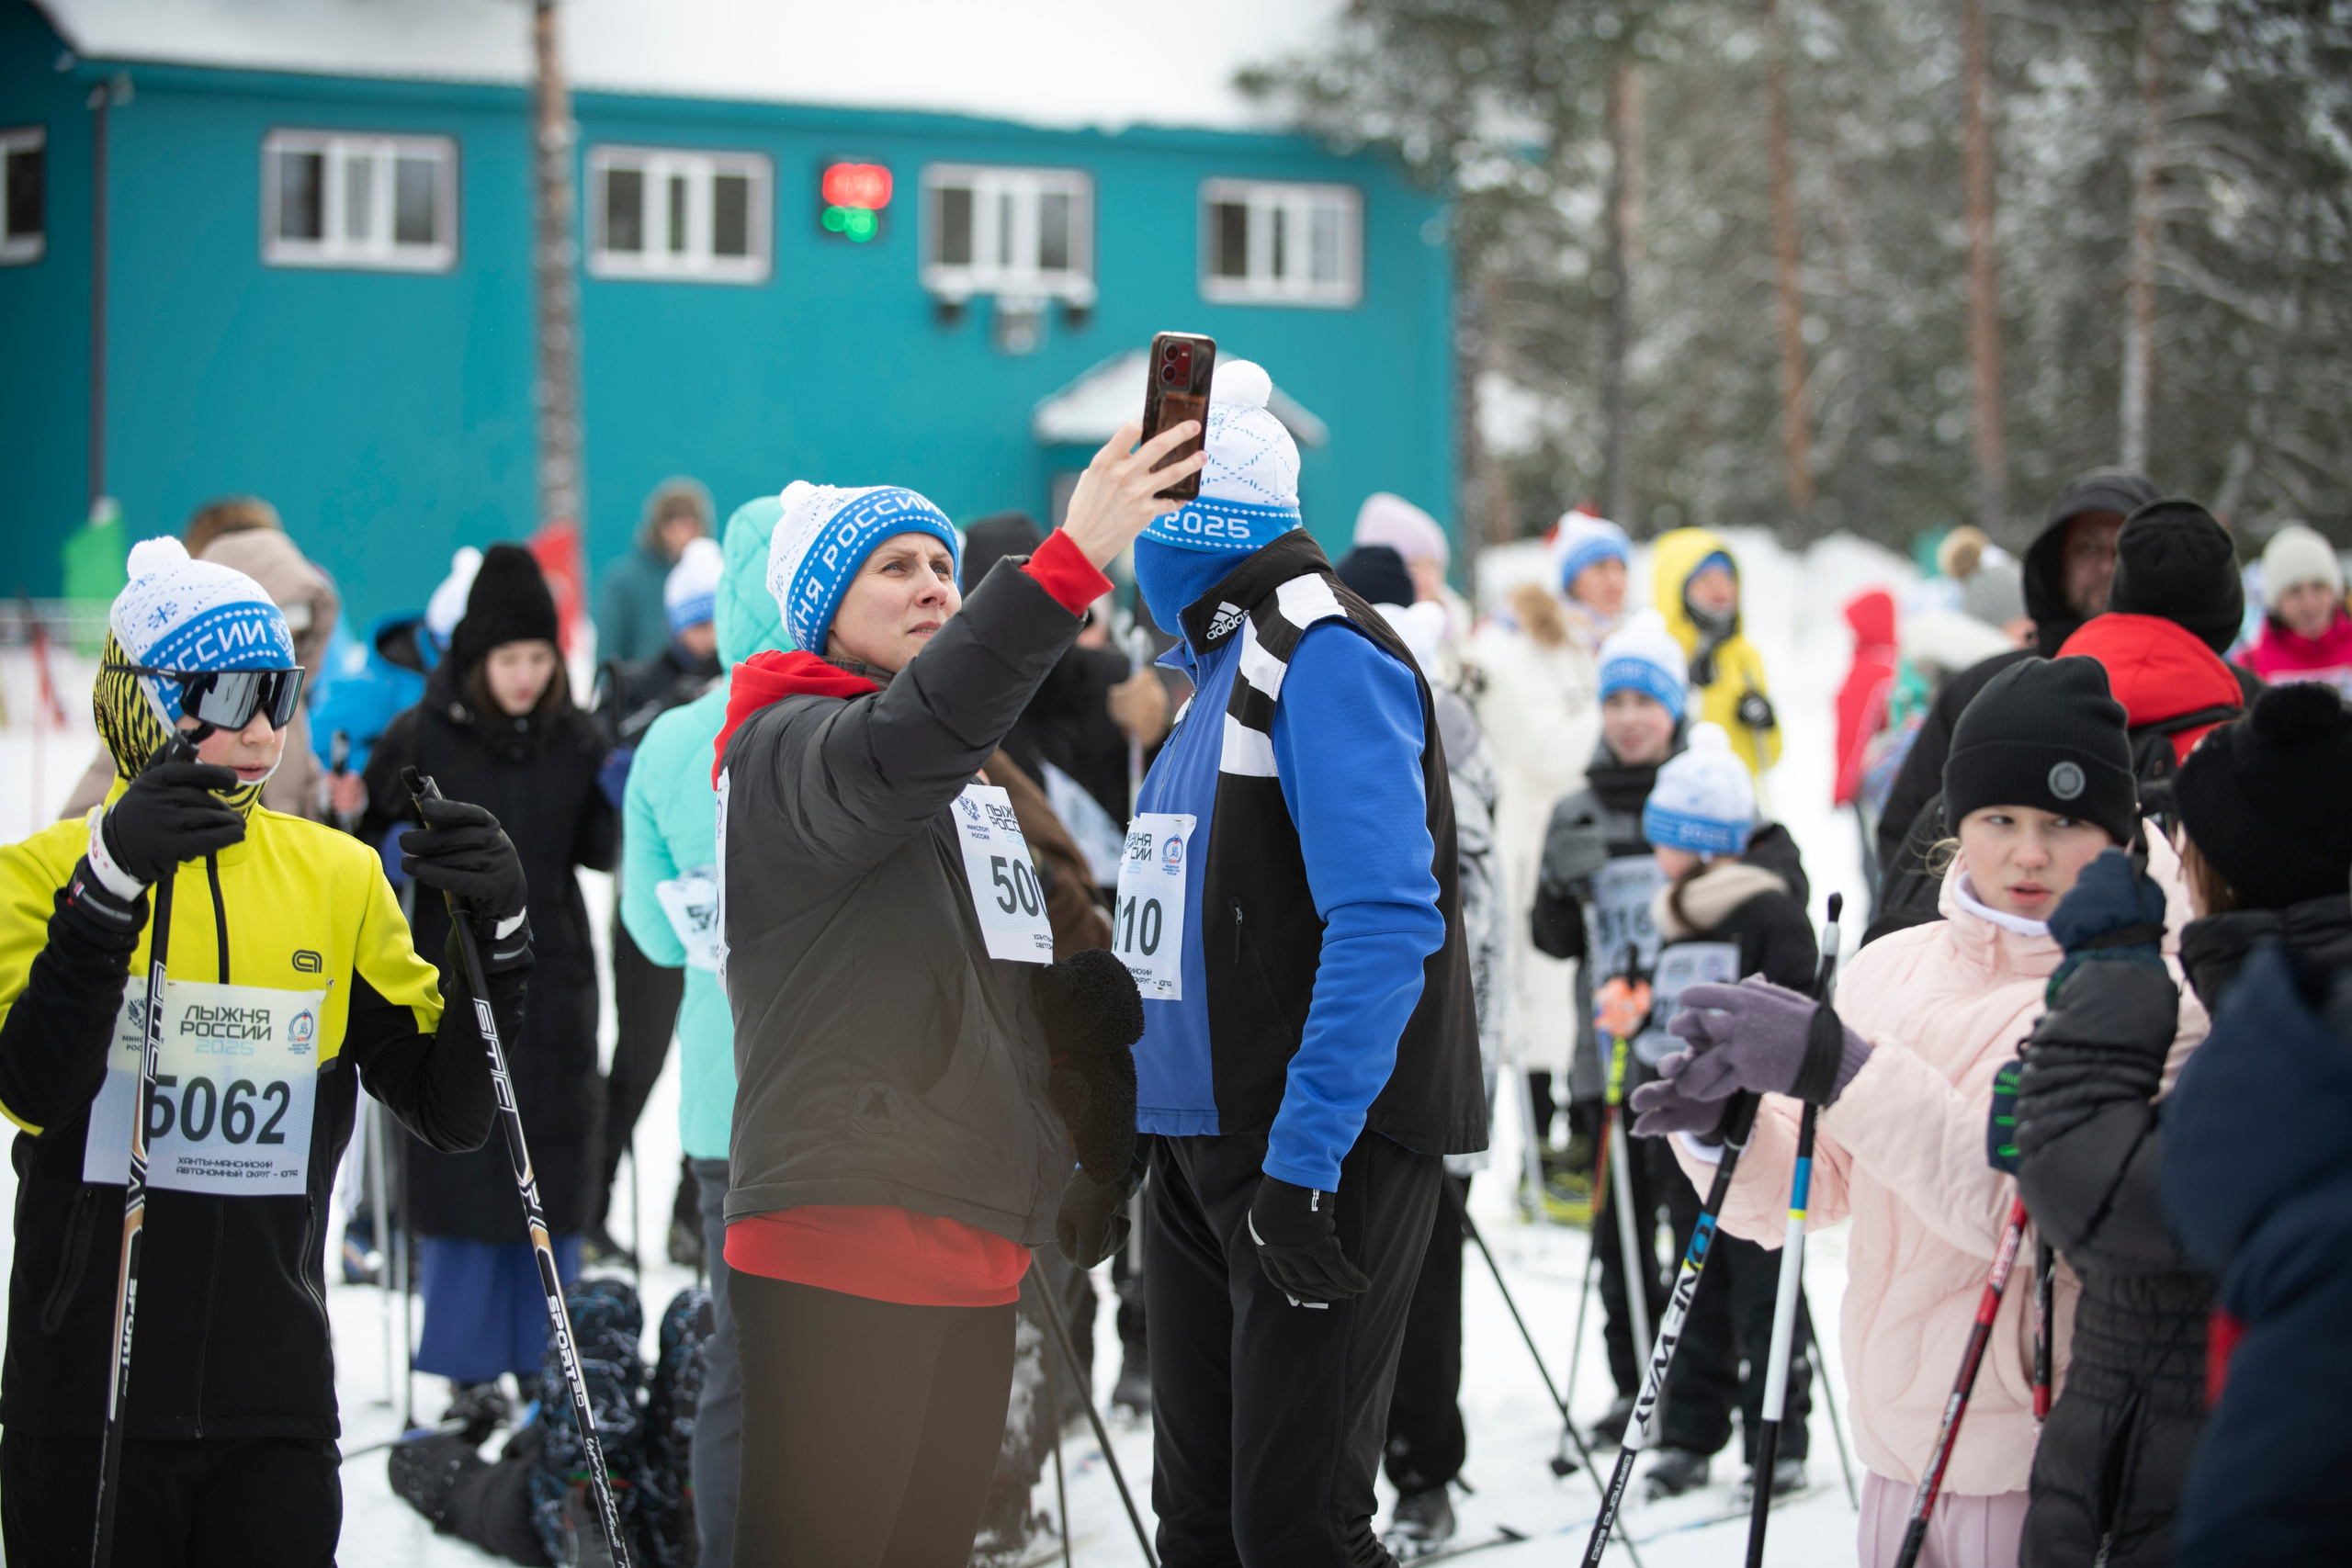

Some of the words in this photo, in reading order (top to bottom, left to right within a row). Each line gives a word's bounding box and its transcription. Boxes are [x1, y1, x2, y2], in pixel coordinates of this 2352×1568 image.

[1164, 511, 1250, 539] 2025
[794, 577, 825, 651] ЖНЯ
[822, 496, 941, 571] РОССИИ
[1206, 609, 1250, 640] adidas
[152, 619, 267, 693] ОССИИ
[185, 1005, 270, 1024] ЛЫЖНЯ
[180, 1021, 271, 1041] РОССИИ
[195, 1038, 254, 1056] 2025
[149, 1074, 291, 1145] 5062
[176, 1167, 243, 1178] АВТОНОМНЫЙ
[246, 1170, 271, 1179] ОКРУГ
[280, 1169, 299, 1178] ЮГРА
[177, 1156, 273, 1168] ХАНТЫ-МАНСИЙСКИЙ
[548, 1294, 577, 1380] SPORT
[1602, 1454, 1633, 1526] DIAMOND
